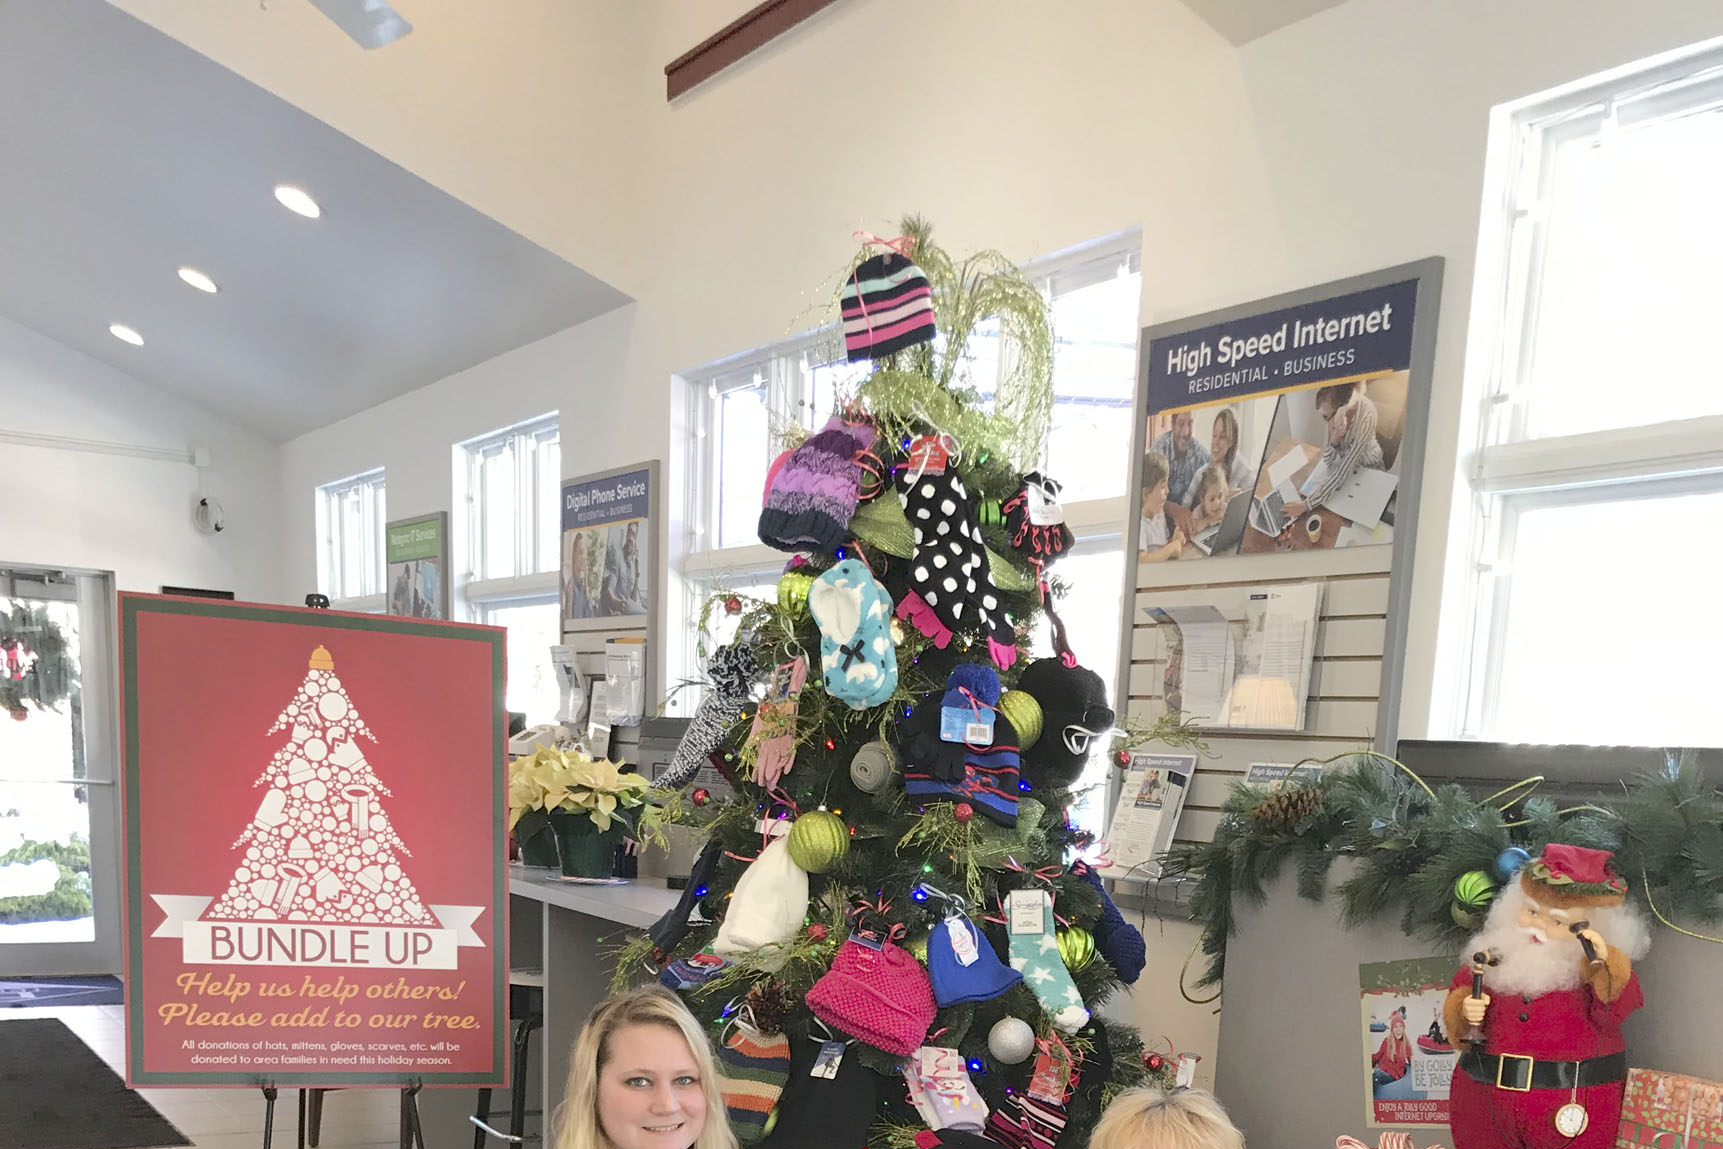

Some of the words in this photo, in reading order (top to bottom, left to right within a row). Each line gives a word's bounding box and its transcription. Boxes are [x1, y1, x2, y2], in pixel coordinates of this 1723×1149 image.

[1167, 341, 1211, 376] High
[1217, 324, 1286, 367] Speed
[1294, 303, 1392, 348] Internet
[1188, 366, 1268, 394] RESIDENTIAL
[1283, 349, 1355, 376] BUSINESS
[567, 490, 590, 512] Digital
[592, 488, 615, 505] Phone
[617, 480, 646, 500] Service
[610, 504, 632, 516] BUSINESS
[1266, 768, 1284, 777] Speed
[210, 926, 369, 964] BUNDLE
[385, 931, 433, 965] UP
[176, 972, 251, 1003] Help
[259, 981, 296, 998] us
[299, 975, 360, 1004] help
[366, 978, 466, 1000] others!
[158, 1003, 266, 1028] Please
[271, 1006, 330, 1028] add
[335, 1009, 362, 1028] to
[368, 1014, 418, 1029] our
[423, 1010, 481, 1030] tree.
[182, 1040, 195, 1049] All
[197, 1040, 250, 1050] donations
[252, 1041, 263, 1050] of
[265, 1041, 289, 1051] hats,
[291, 1041, 328, 1051] mittens,
[330, 1041, 365, 1052] gloves,
[368, 1043, 407, 1052] scarves,
[409, 1042, 428, 1051] etc.
[430, 1042, 444, 1051] will
[446, 1042, 460, 1051] be
[191, 1055, 237, 1064] donated
[240, 1055, 250, 1064] to
[280, 1055, 317, 1065] families
[320, 1056, 328, 1064] in
[331, 1056, 357, 1065] need
[360, 1056, 375, 1065] this
[378, 1055, 414, 1066] holiday
[416, 1057, 452, 1065] season.
[1415, 1060, 1425, 1072] BY
[1427, 1059, 1452, 1072] GOLLY
[1415, 1073, 1426, 1086] BE
[1428, 1073, 1451, 1087] JOLLY
[1379, 1102, 1397, 1112] ENJOY
[1419, 1103, 1437, 1111] GOOD
[1395, 1111, 1423, 1121] INTERNET
[1424, 1112, 1449, 1121] UPGRAD
